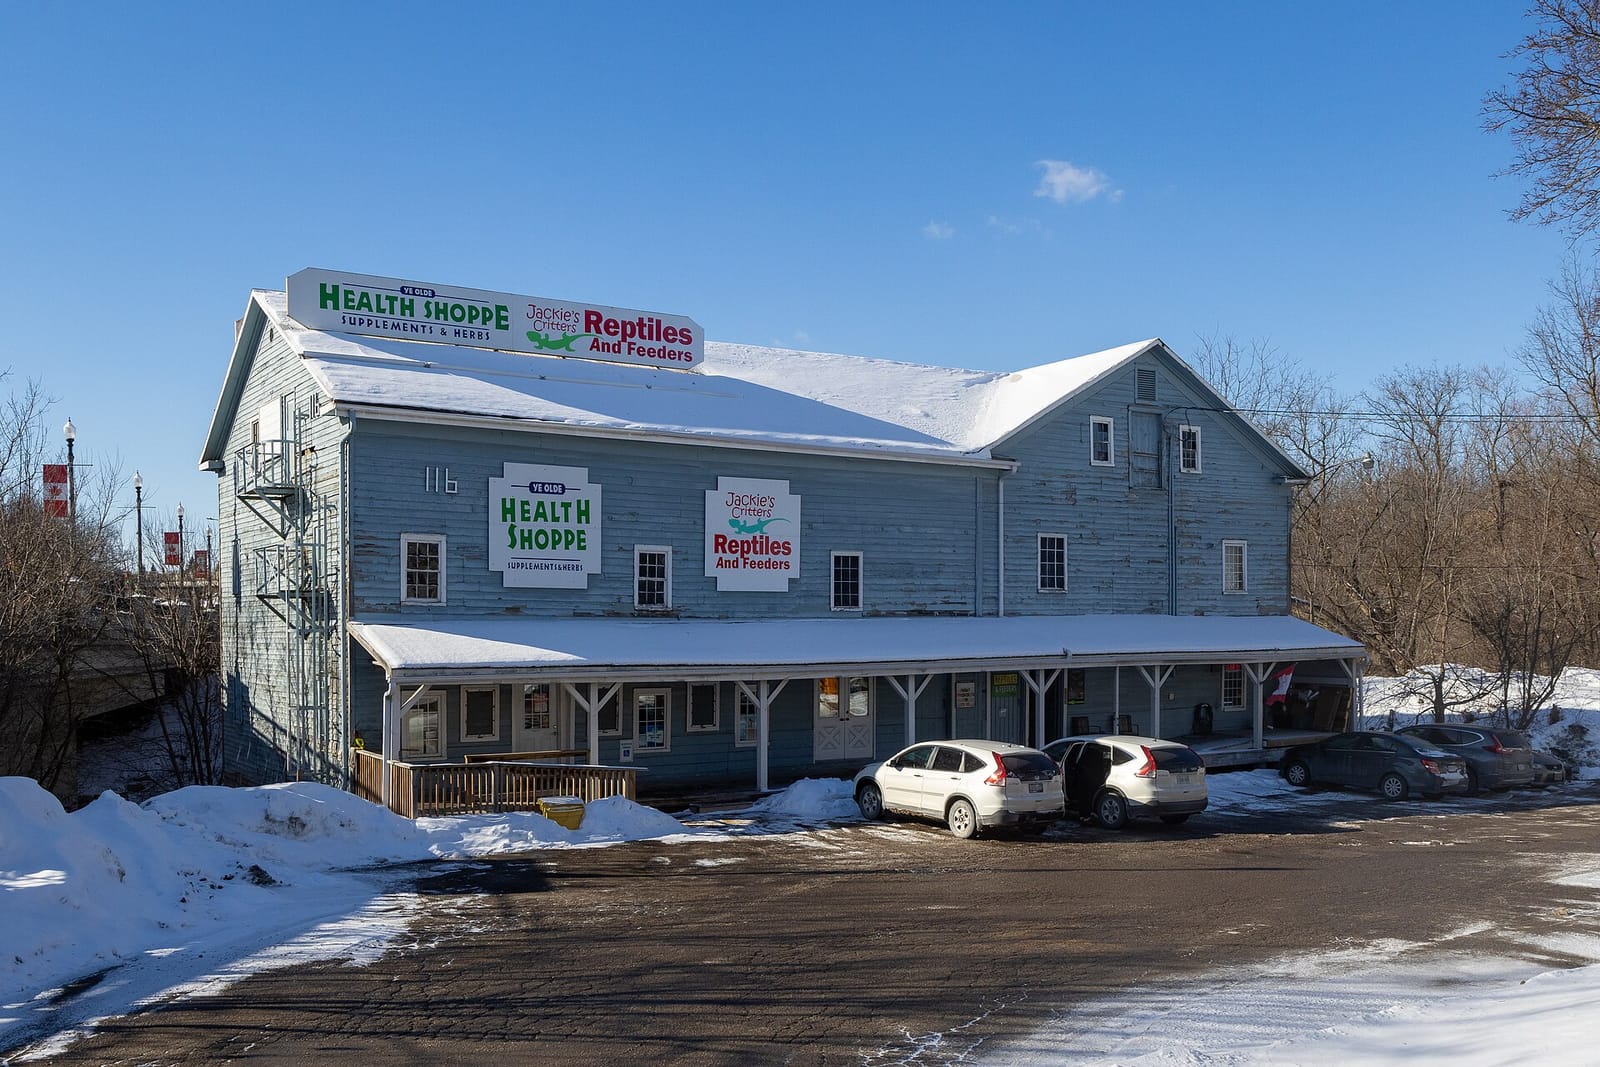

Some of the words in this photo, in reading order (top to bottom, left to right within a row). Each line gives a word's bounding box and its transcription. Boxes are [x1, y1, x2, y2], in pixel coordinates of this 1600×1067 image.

[403, 287, 414, 295] YE
[414, 288, 433, 297] OLDE
[319, 283, 415, 318] HEALTH
[424, 300, 509, 331] SHOPPE
[526, 304, 580, 324] Jackie's
[342, 315, 433, 335] SUPPLEMENTS
[440, 327, 447, 336] &
[454, 329, 490, 341] HERBS
[533, 319, 577, 334] Critters
[584, 309, 693, 346] Reptiles
[589, 337, 622, 354] And
[627, 342, 693, 362] Feeders
[425, 466, 458, 494] 116
[532, 483, 543, 492] YE
[544, 484, 563, 494] OLDE
[501, 497, 591, 524] HEALTH
[725, 492, 775, 508] Jackie's
[731, 506, 772, 518] Critters
[507, 523, 587, 550] SHOPPE
[714, 534, 792, 559] Reptiles
[716, 557, 739, 569] And
[743, 558, 791, 570] Feeders
